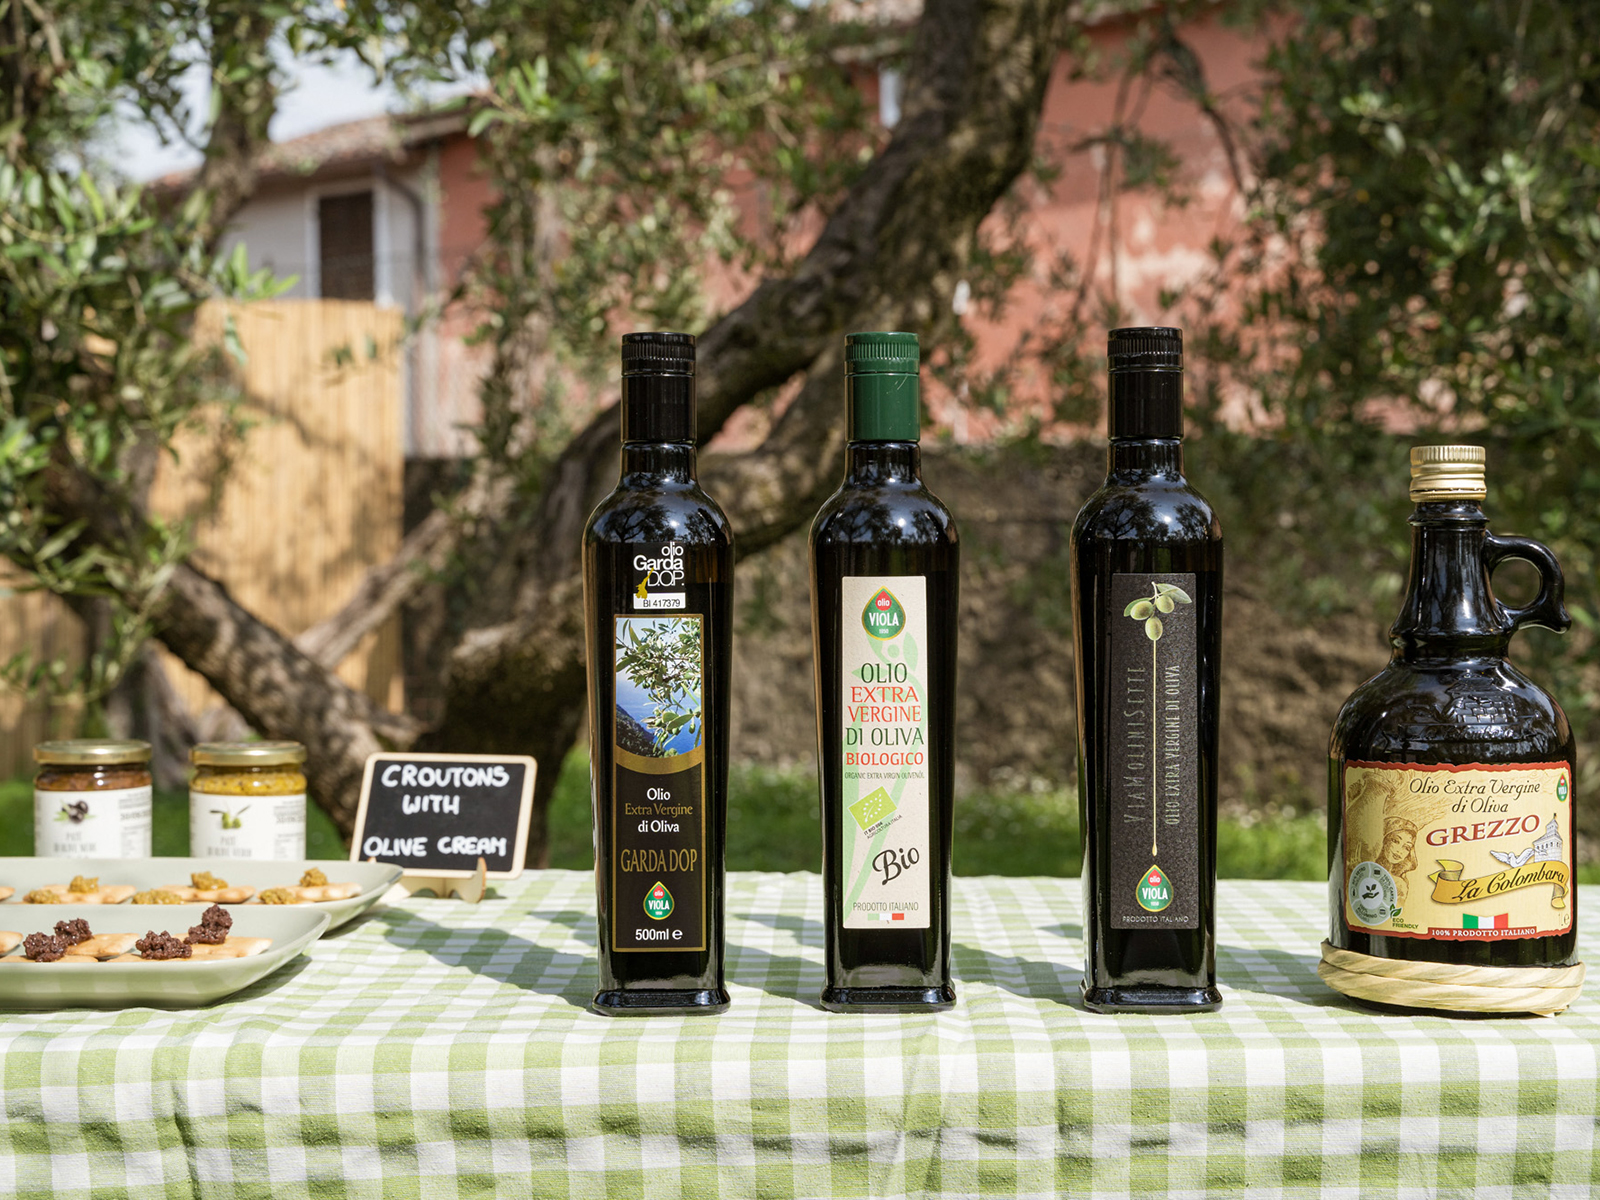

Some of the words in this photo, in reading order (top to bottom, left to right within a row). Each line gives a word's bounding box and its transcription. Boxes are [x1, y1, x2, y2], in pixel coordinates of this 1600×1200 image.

[661, 541, 684, 556] olio
[633, 554, 684, 571] Garda
[653, 599, 680, 607] 417379
[877, 598, 890, 607] olio
[869, 612, 899, 626] VIOLA
[861, 662, 908, 683] OLIO
[1165, 665, 1180, 695] OLIVA
[851, 686, 919, 703] EXTRA
[847, 705, 922, 723] VERGINE
[1165, 700, 1180, 711] DI
[845, 727, 863, 746] DI
[871, 727, 925, 746] OLIVA
[1165, 714, 1180, 760] VERGINE
[845, 752, 924, 766] BIOLOGICO
[381, 764, 510, 788] CROUTONS
[844, 771, 866, 780] ORGANIC
[867, 772, 883, 780] EXTRA
[884, 772, 900, 780] VIRGIN
[1165, 763, 1180, 797] EXTRA
[646, 787, 671, 801] Olio
[1409, 776, 1440, 794] Olio
[1443, 779, 1486, 795] Extra
[1489, 779, 1541, 800] Vergine
[402, 794, 460, 815] WITH
[625, 803, 652, 815] Extra
[653, 803, 694, 818] Vergine
[1165, 801, 1180, 825] OLIO
[1451, 797, 1467, 813] di
[1470, 796, 1509, 813] Oliva
[637, 820, 649, 833] di
[650, 819, 680, 833] Oliva
[1425, 814, 1541, 847] GREZZO
[363, 836, 428, 857] OLIVE
[437, 835, 507, 857] CREAM
[620, 848, 668, 872] GARDA
[669, 848, 698, 872] DOP
[872, 847, 920, 886] Bio
[1452, 879, 1484, 901] La
[1487, 862, 1565, 894] Colombara
[1142, 887, 1169, 900] VIOLA
[648, 900, 670, 910] VIOLA
[853, 902, 888, 912] PRODOTTO
[889, 902, 919, 911] ITALIANO
[1122, 915, 1159, 923] PRODOTTO
[1160, 915, 1190, 923] ITALANO
[635, 928, 670, 941] 500ml
[1452, 929, 1499, 937] PRODOTTO
[1500, 928, 1536, 937] ITALIANO
